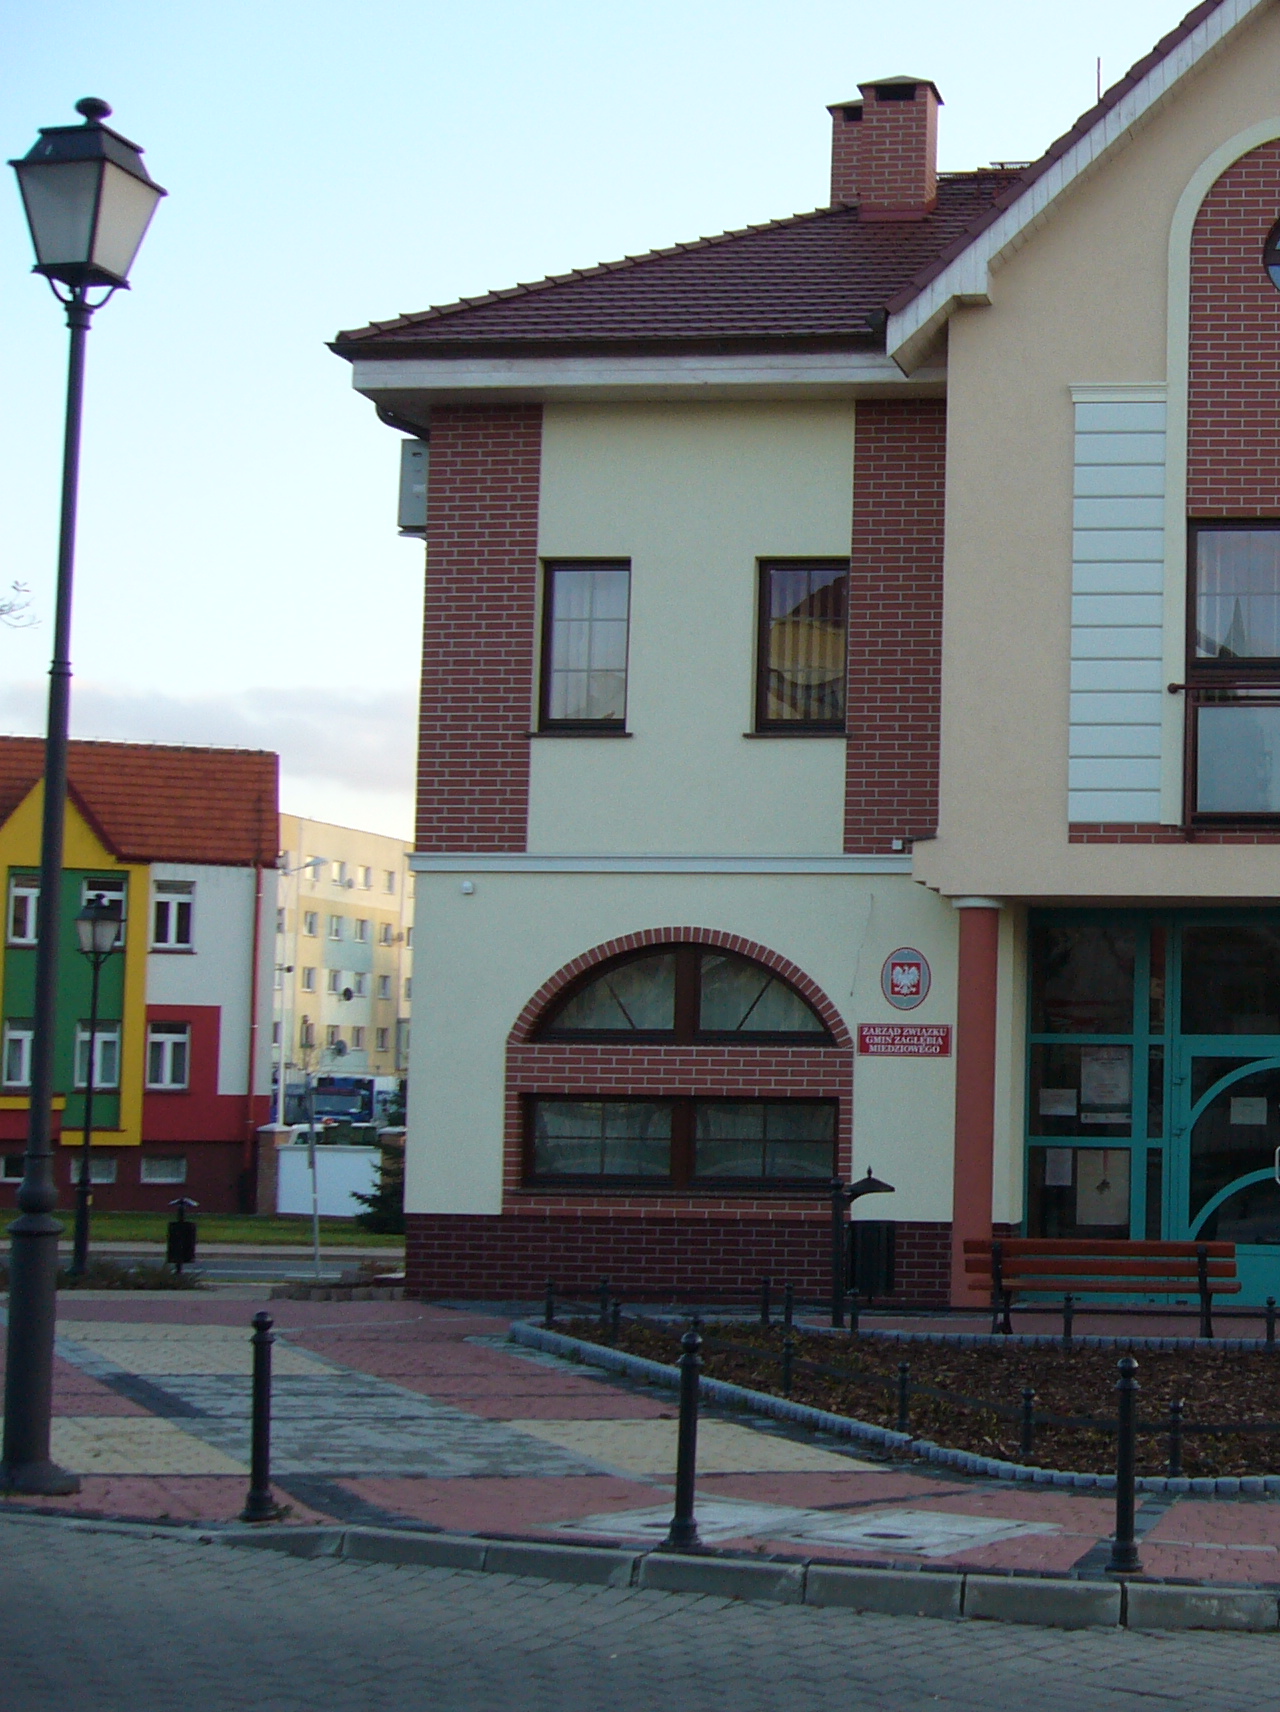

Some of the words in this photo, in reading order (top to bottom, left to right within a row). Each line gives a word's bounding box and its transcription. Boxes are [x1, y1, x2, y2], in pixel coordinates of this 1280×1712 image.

[862, 1027, 901, 1037] ZARZĄD
[903, 1028, 946, 1037] ZWIĄZKU
[869, 1045, 940, 1053] MIEDZIOWEGO
